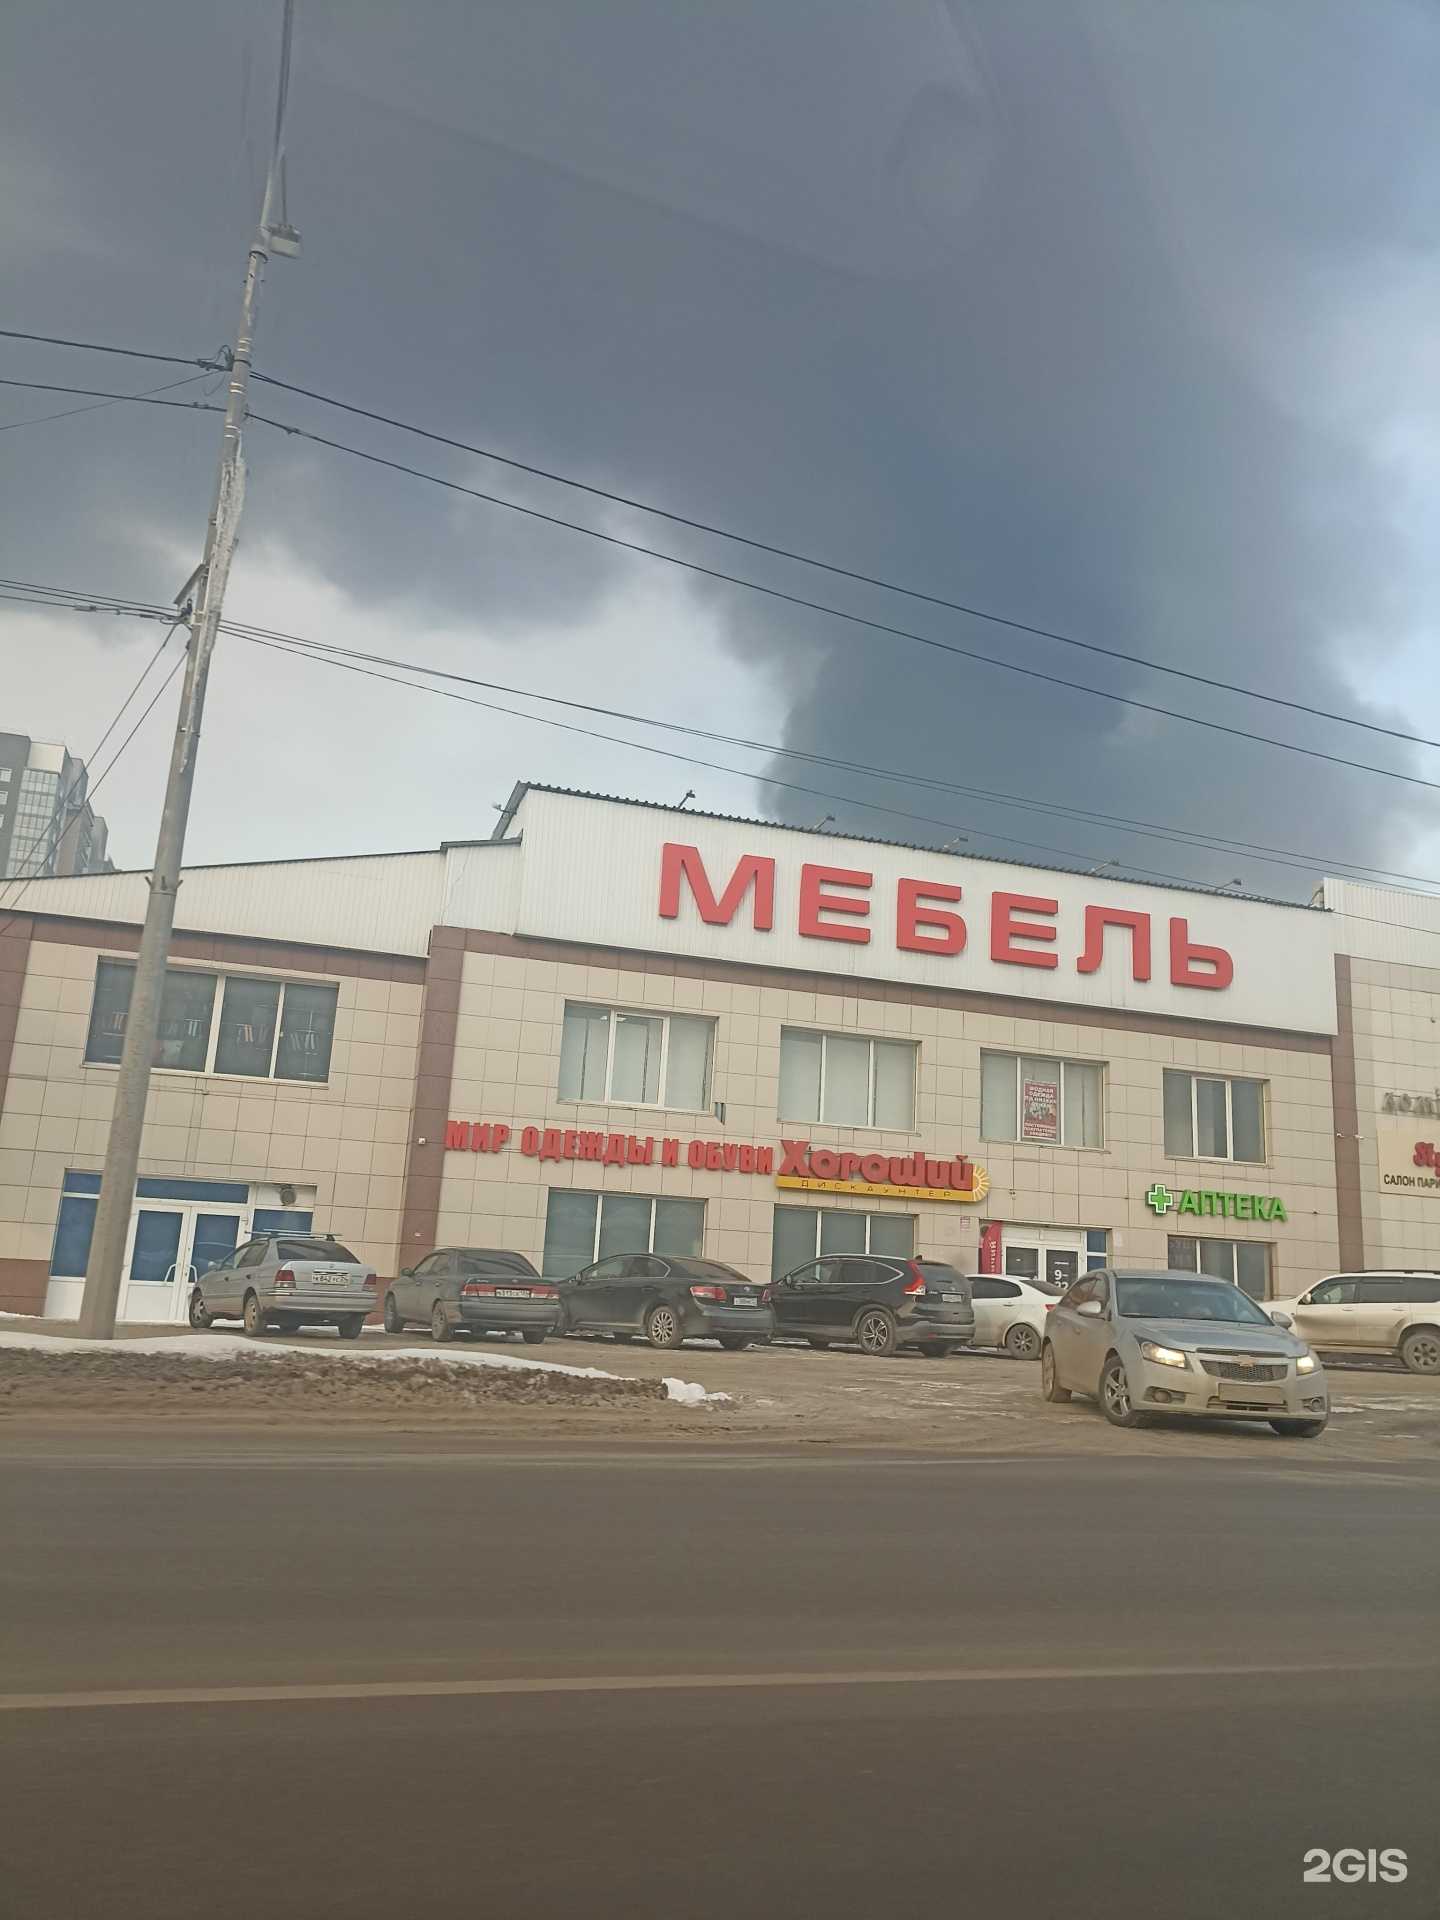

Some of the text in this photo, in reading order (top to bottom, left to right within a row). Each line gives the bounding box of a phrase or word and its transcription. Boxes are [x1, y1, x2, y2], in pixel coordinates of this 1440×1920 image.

[658, 842, 1233, 990] МЕБЕЛЬ
[445, 1120, 773, 1175] МИР ОДЕЖДЫ И ОБУВИ
[801, 1179, 952, 1198] ДИСКАУНТЕР
[1383, 1174, 1415, 1187] САЛОН
[1177, 1188, 1288, 1222] АПТЕКА
